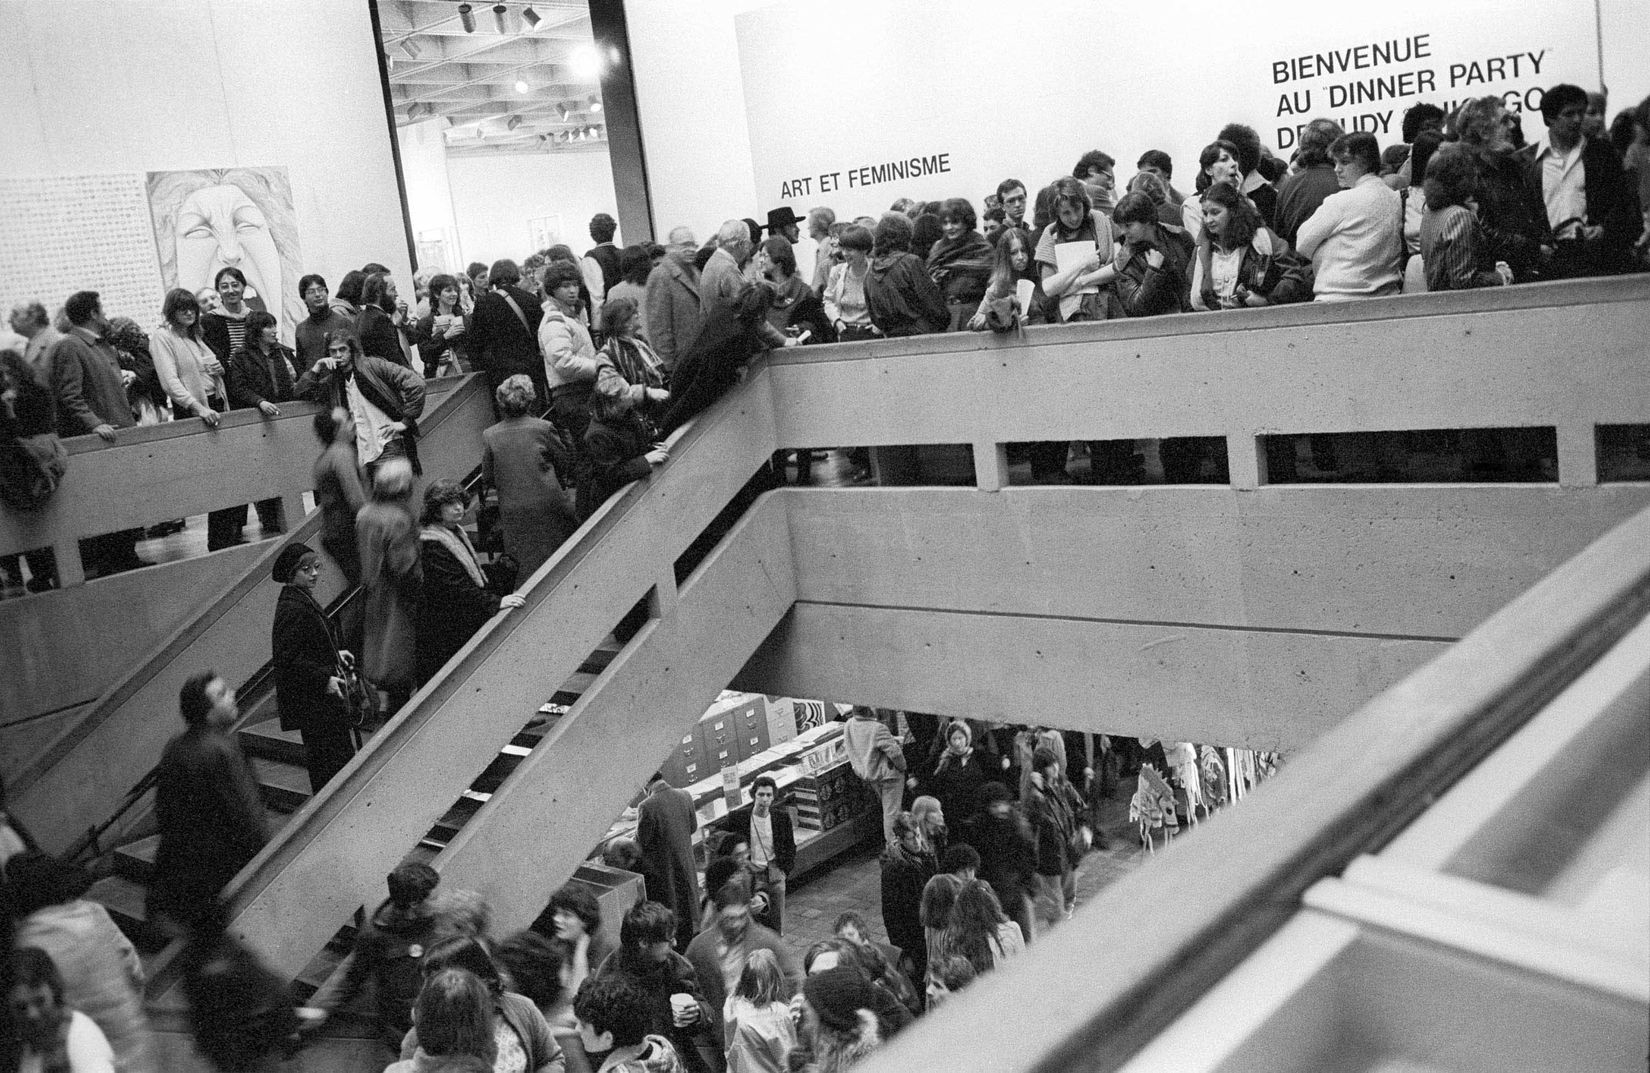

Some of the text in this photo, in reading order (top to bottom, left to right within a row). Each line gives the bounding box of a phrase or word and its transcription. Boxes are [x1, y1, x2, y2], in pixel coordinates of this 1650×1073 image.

[1272, 33, 1432, 84] BIENVENUE
[1276, 89, 1312, 117] AU
[780, 153, 951, 199] ART ET FEMINISME
